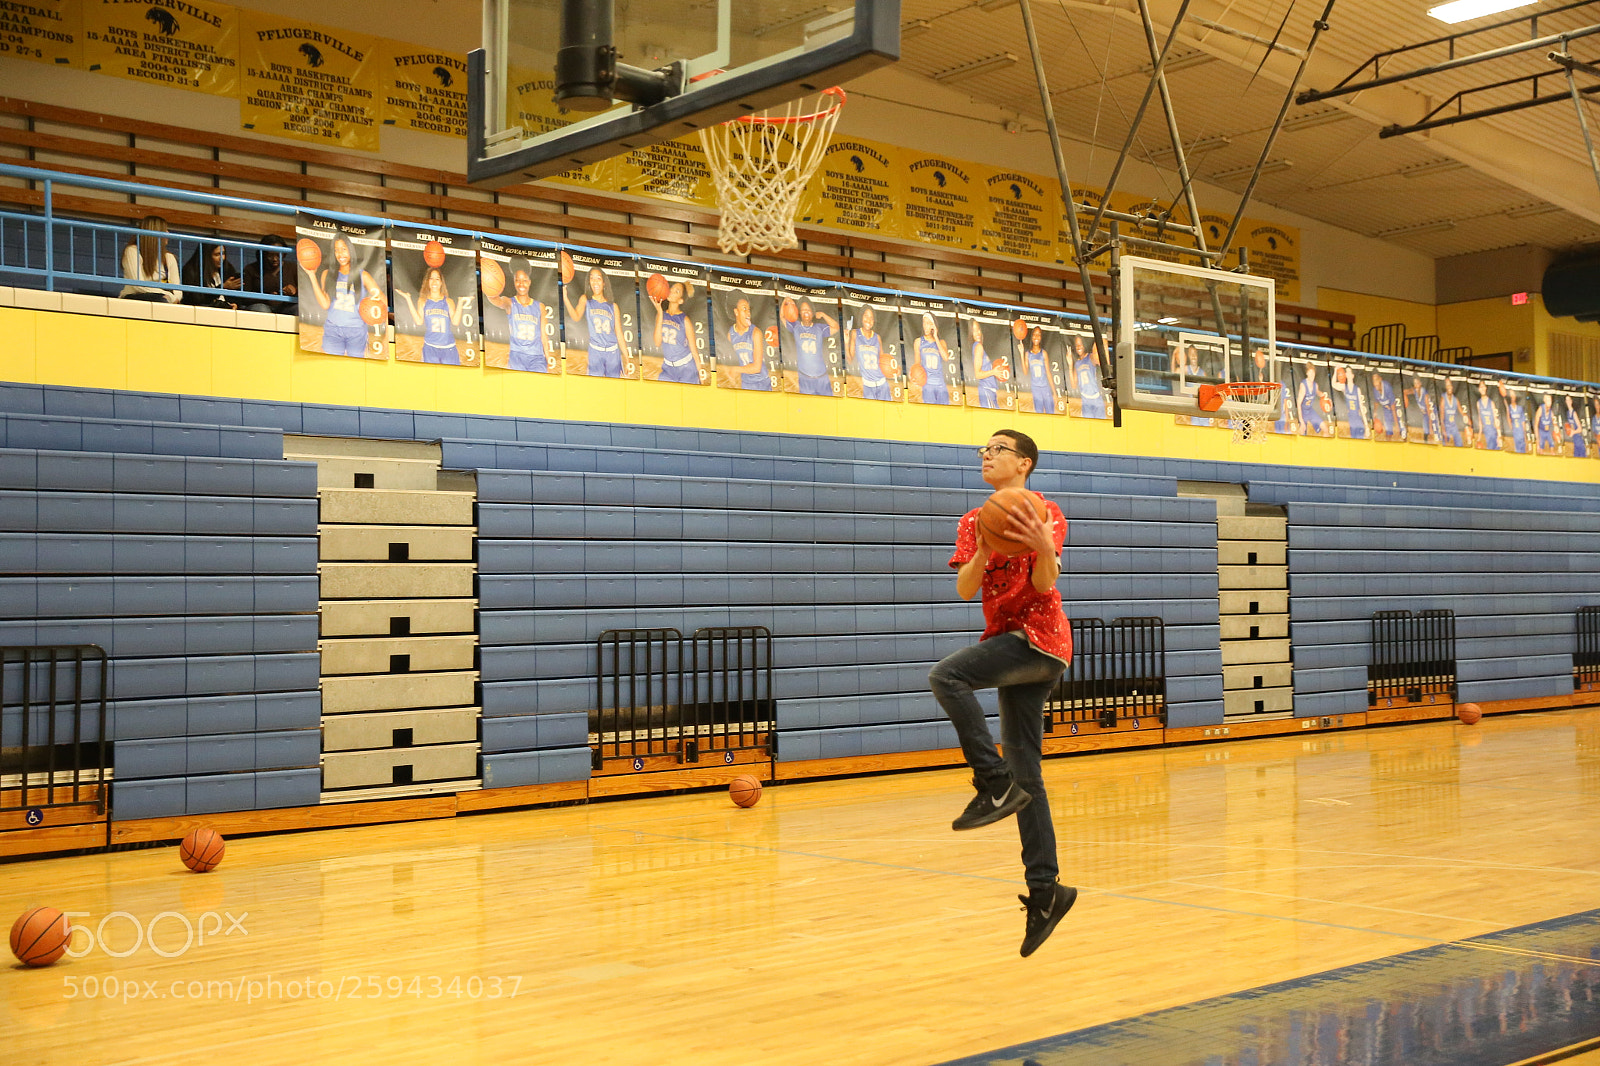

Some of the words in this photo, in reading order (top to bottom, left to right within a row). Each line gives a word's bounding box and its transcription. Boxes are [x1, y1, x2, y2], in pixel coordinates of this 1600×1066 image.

[0, 1, 62, 21] KETBALL
[0, 22, 74, 44] HAMPIONS
[108, 26, 138, 39] BOYS
[143, 33, 216, 54] BASKETBALL
[16, 45, 42, 58] 27-5
[144, 42, 190, 58] DISTRICT
[194, 52, 236, 67] CHAMPS
[256, 28, 364, 62] PFLUGERVILLE
[115, 46, 146, 59] AREA
[152, 53, 212, 71] FINALISTS
[140, 60, 188, 76] 2004-05
[394, 54, 468, 73] PFLUGERVI
[127, 67, 175, 83] RECORD
[177, 76, 200, 87] 31-3
[270, 62, 292, 74] BOYS
[296, 68, 352, 85] BASKETBALL
[247, 68, 290, 83] 15-AAAAA
[294, 77, 334, 92] DISTRICT
[338, 85, 372, 99] CHAMPS
[280, 84, 304, 96] AREA
[307, 88, 343, 102] CHAMPS
[395, 80, 420, 92] BOYS
[426, 86, 468, 102] BASKET
[247, 96, 281, 110] REGION
[313, 108, 374, 126] SEMIFINALIST
[257, 89, 324, 108] QUARTERFINAL
[330, 102, 365, 115] CHAMPS
[387, 96, 434, 113] DISTRICT
[439, 108, 468, 118] CHAM
[419, 94, 467, 110] 14-AAAAA
[410, 119, 451, 134] RECORD
[519, 112, 542, 123] BOYS
[283, 122, 319, 136] RECORD
[322, 128, 340, 139] 32-6
[655, 140, 706, 154] ASKETBAL
[825, 142, 890, 168] PFLUGERVILLE
[632, 150, 670, 164] DISTRICT
[672, 158, 706, 170] CHAMPS
[641, 168, 662, 178] AREA
[664, 170, 699, 184] CHAMPS
[678, 166, 711, 179] CHAMPS
[826, 170, 844, 180] BOYS
[846, 174, 889, 188] BASKETBALL
[909, 159, 970, 184] PFLUGERVILLE
[827, 185, 859, 197] DISTRICT
[861, 192, 889, 202] CHAMPS
[910, 186, 928, 194] BOYS
[929, 190, 968, 203] BASKETBALL
[987, 173, 1044, 197] PFLUGERVILLE
[822, 192, 864, 205] BI-DISTRICT
[866, 198, 893, 210] CHAMPS
[834, 202, 853, 210] AREA
[854, 204, 882, 215] CHAMPS
[1006, 200, 1043, 212] BASKETBALL
[906, 204, 936, 214] DISTRICT
[938, 208, 974, 220] RUNNER-UP
[313, 220, 338, 230] KAYLA
[341, 226, 366, 234] SPARKS
[836, 217, 865, 228] RECORD
[946, 217, 974, 228] FINALIST
[438, 236, 452, 244] KING
[919, 230, 946, 241] RECORD
[481, 242, 504, 252] TAYLOR
[572, 254, 600, 264] SHERIDAN
[646, 263, 668, 272] LONDON
[672, 267, 698, 276] CLARKSON
[370, 288, 383, 354] 2019
[431, 317, 446, 334] 21
[462, 297, 475, 361] 2019
[593, 316, 612, 334] 24
[545, 306, 556, 370] 2019
[623, 314, 636, 375] 2019
[662, 326, 678, 345] 32
[695, 322, 708, 381] 2019
[801, 340, 817, 354] 44
[765, 330, 778, 388] 2018
[828, 338, 840, 393] 2018
[889, 344, 900, 398] 2018
[948, 350, 960, 402] 2018
[1002, 356, 1013, 406] 2018
[1052, 362, 1064, 411] 2018
